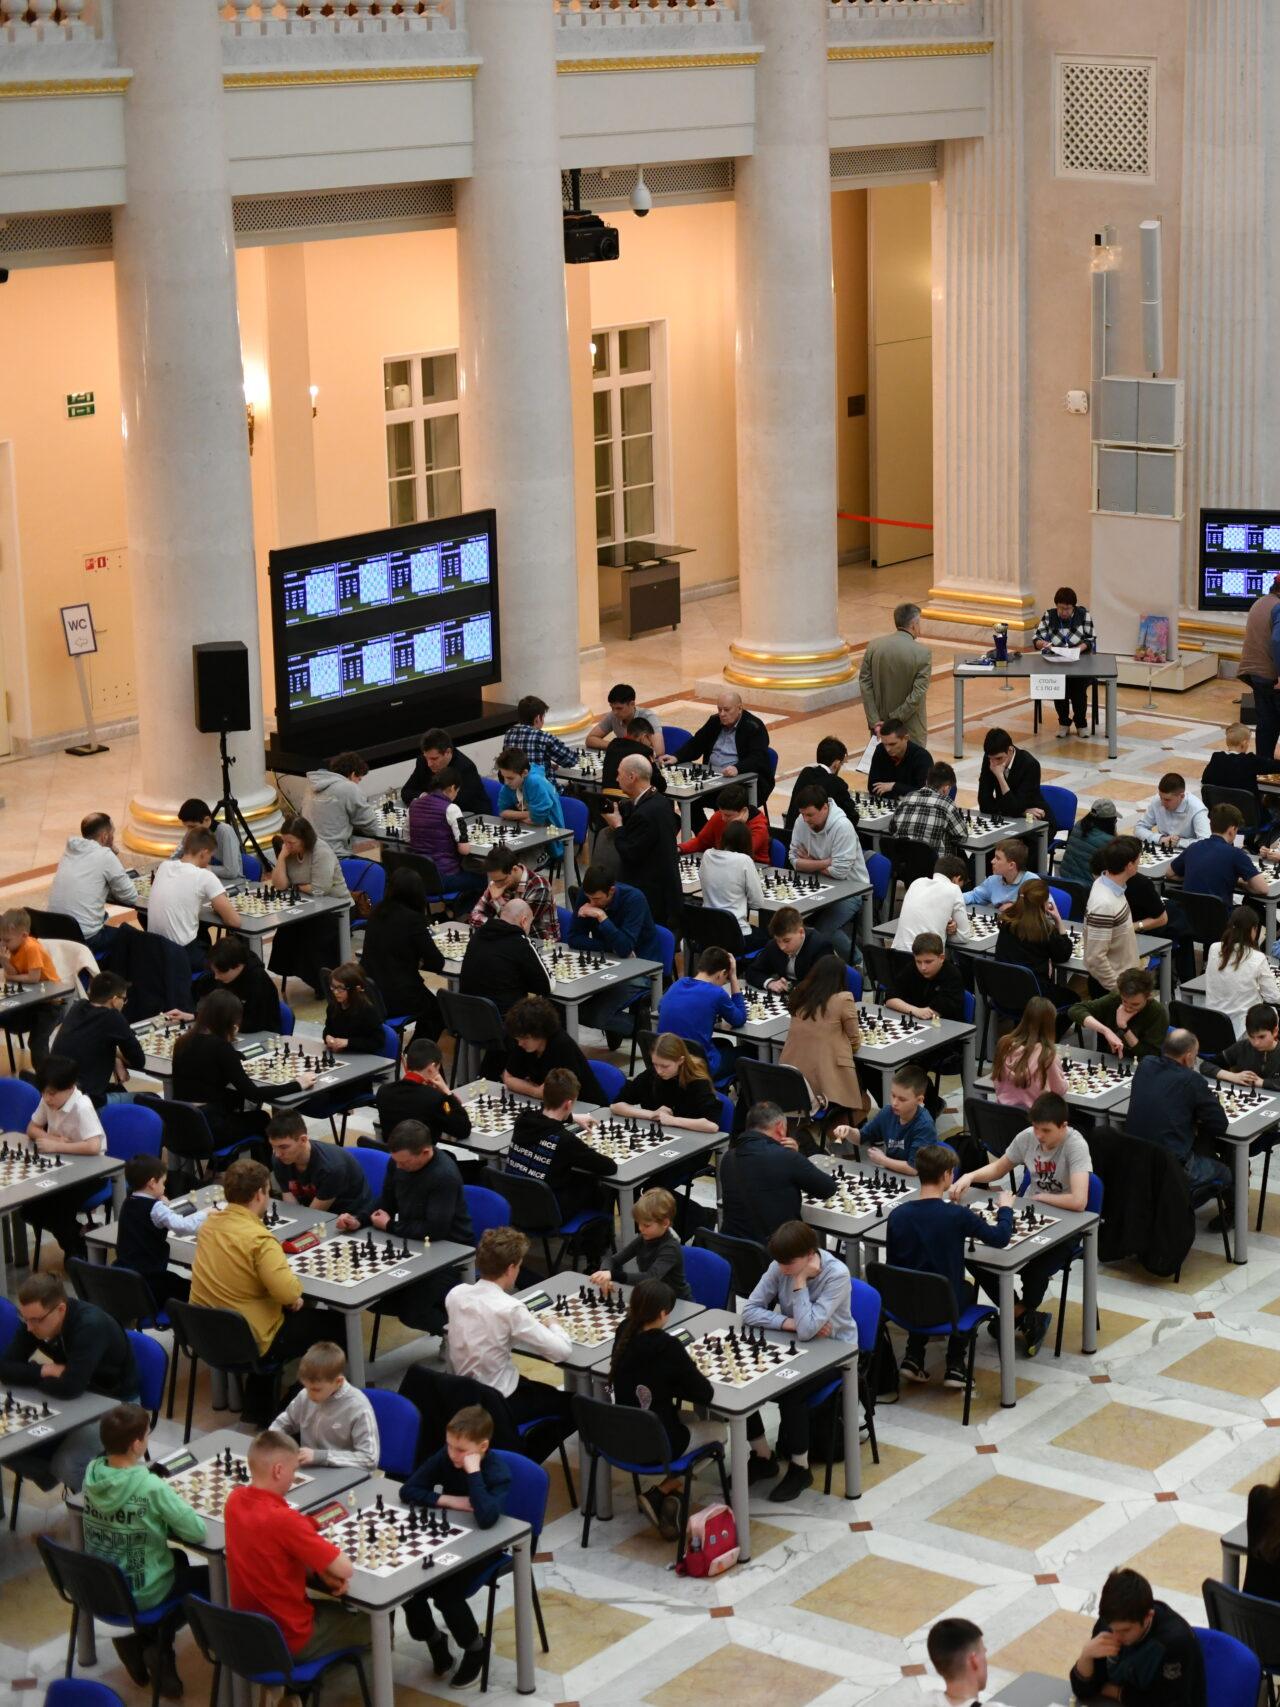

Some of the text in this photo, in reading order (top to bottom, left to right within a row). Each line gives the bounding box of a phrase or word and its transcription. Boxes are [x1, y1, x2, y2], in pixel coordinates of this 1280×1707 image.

[68, 618, 88, 631] WC
[540, 1139, 557, 1151] NICE
[513, 1144, 533, 1158] SUPER
[533, 1153, 552, 1165] NICE
[510, 1159, 528, 1172] SUPER
[528, 1168, 546, 1180] NICE
